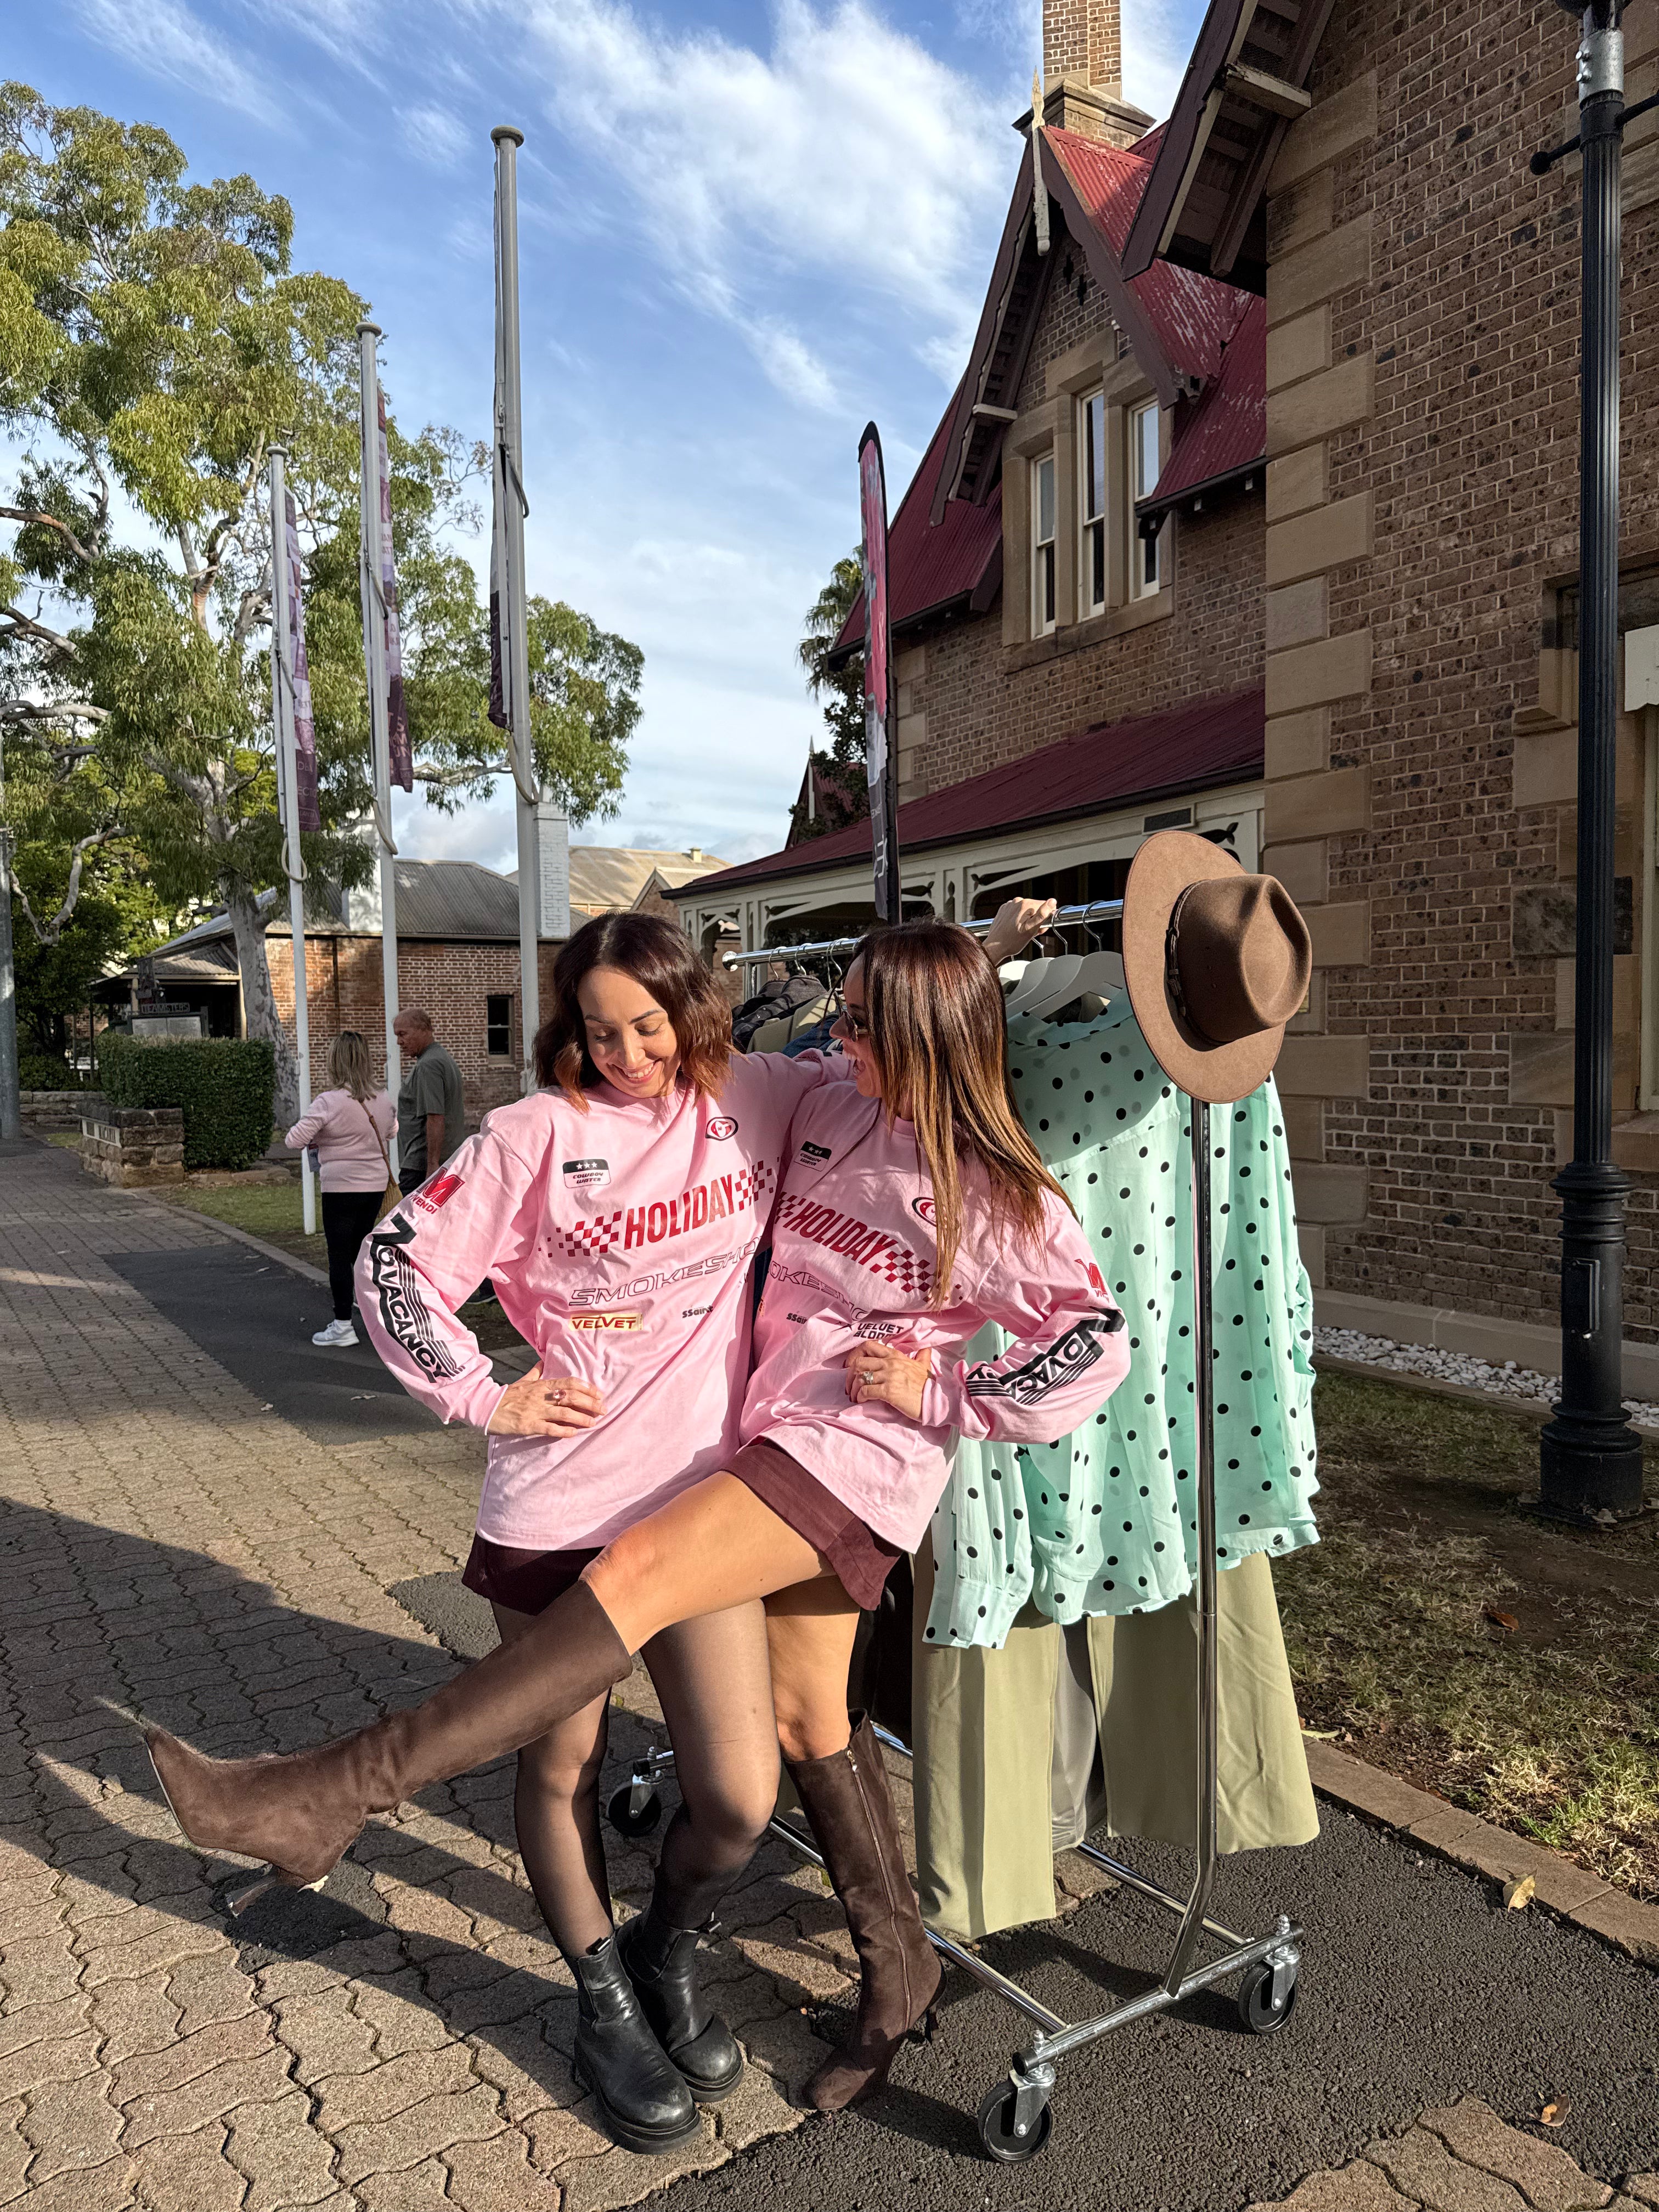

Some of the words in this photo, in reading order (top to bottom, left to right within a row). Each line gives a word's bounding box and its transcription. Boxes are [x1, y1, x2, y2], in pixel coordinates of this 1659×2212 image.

[624, 1173, 735, 1250] HOLIDAY
[782, 1201, 899, 1266] HOLIDAY
[569, 1236, 762, 1306] SMOKESHO
[572, 1317, 637, 1329] VELVET
